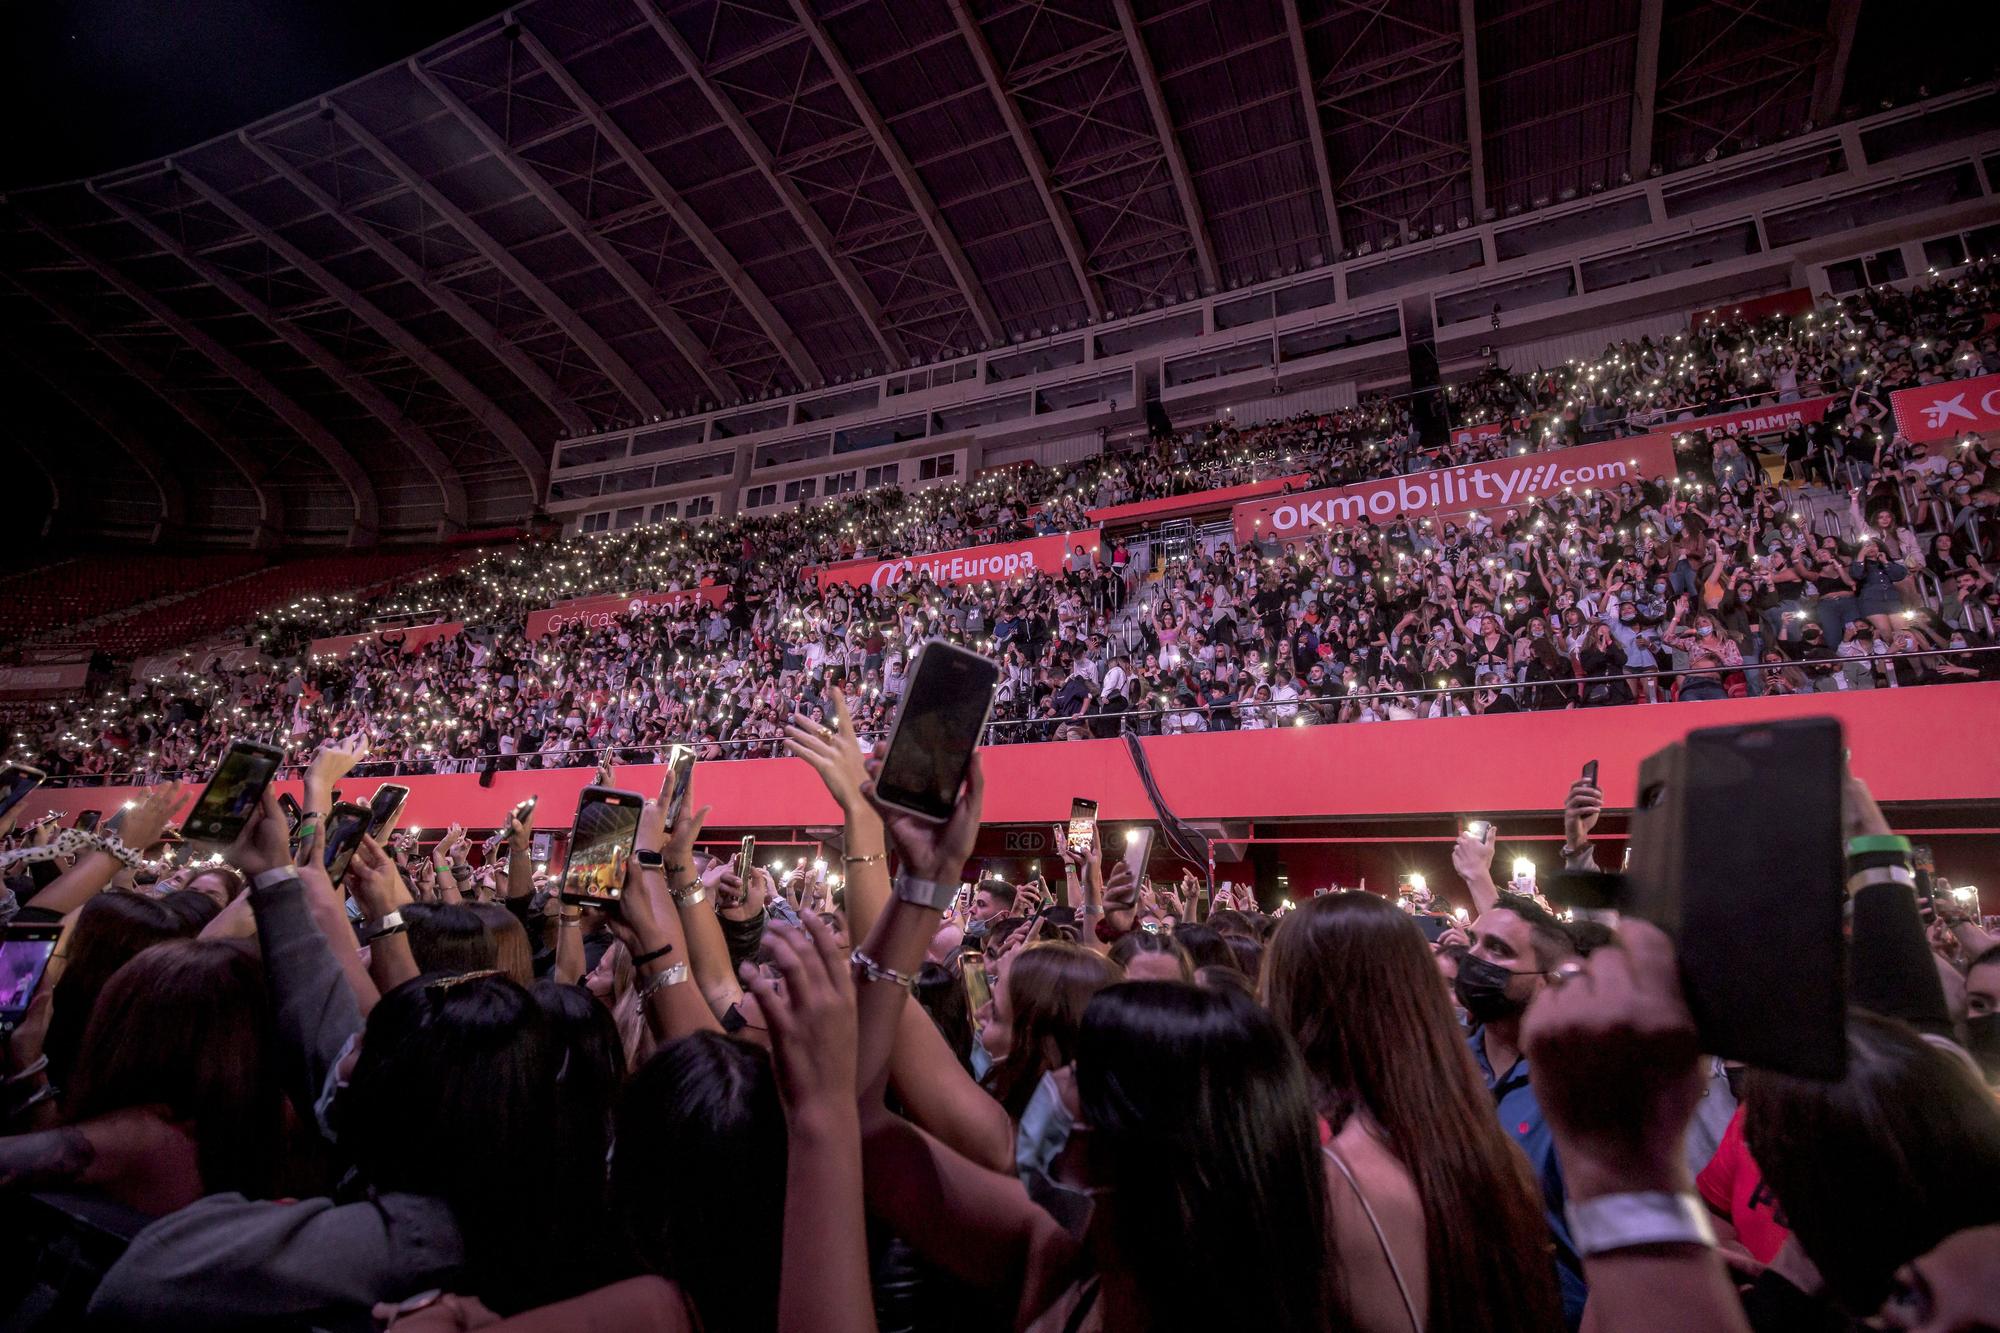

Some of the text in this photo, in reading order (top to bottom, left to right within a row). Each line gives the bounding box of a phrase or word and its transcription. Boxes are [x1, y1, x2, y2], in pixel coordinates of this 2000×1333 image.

[1741, 411, 1803, 433] DAMM
[919, 551, 1034, 581] AirEuropa
[1006, 832, 1045, 850] RCD
